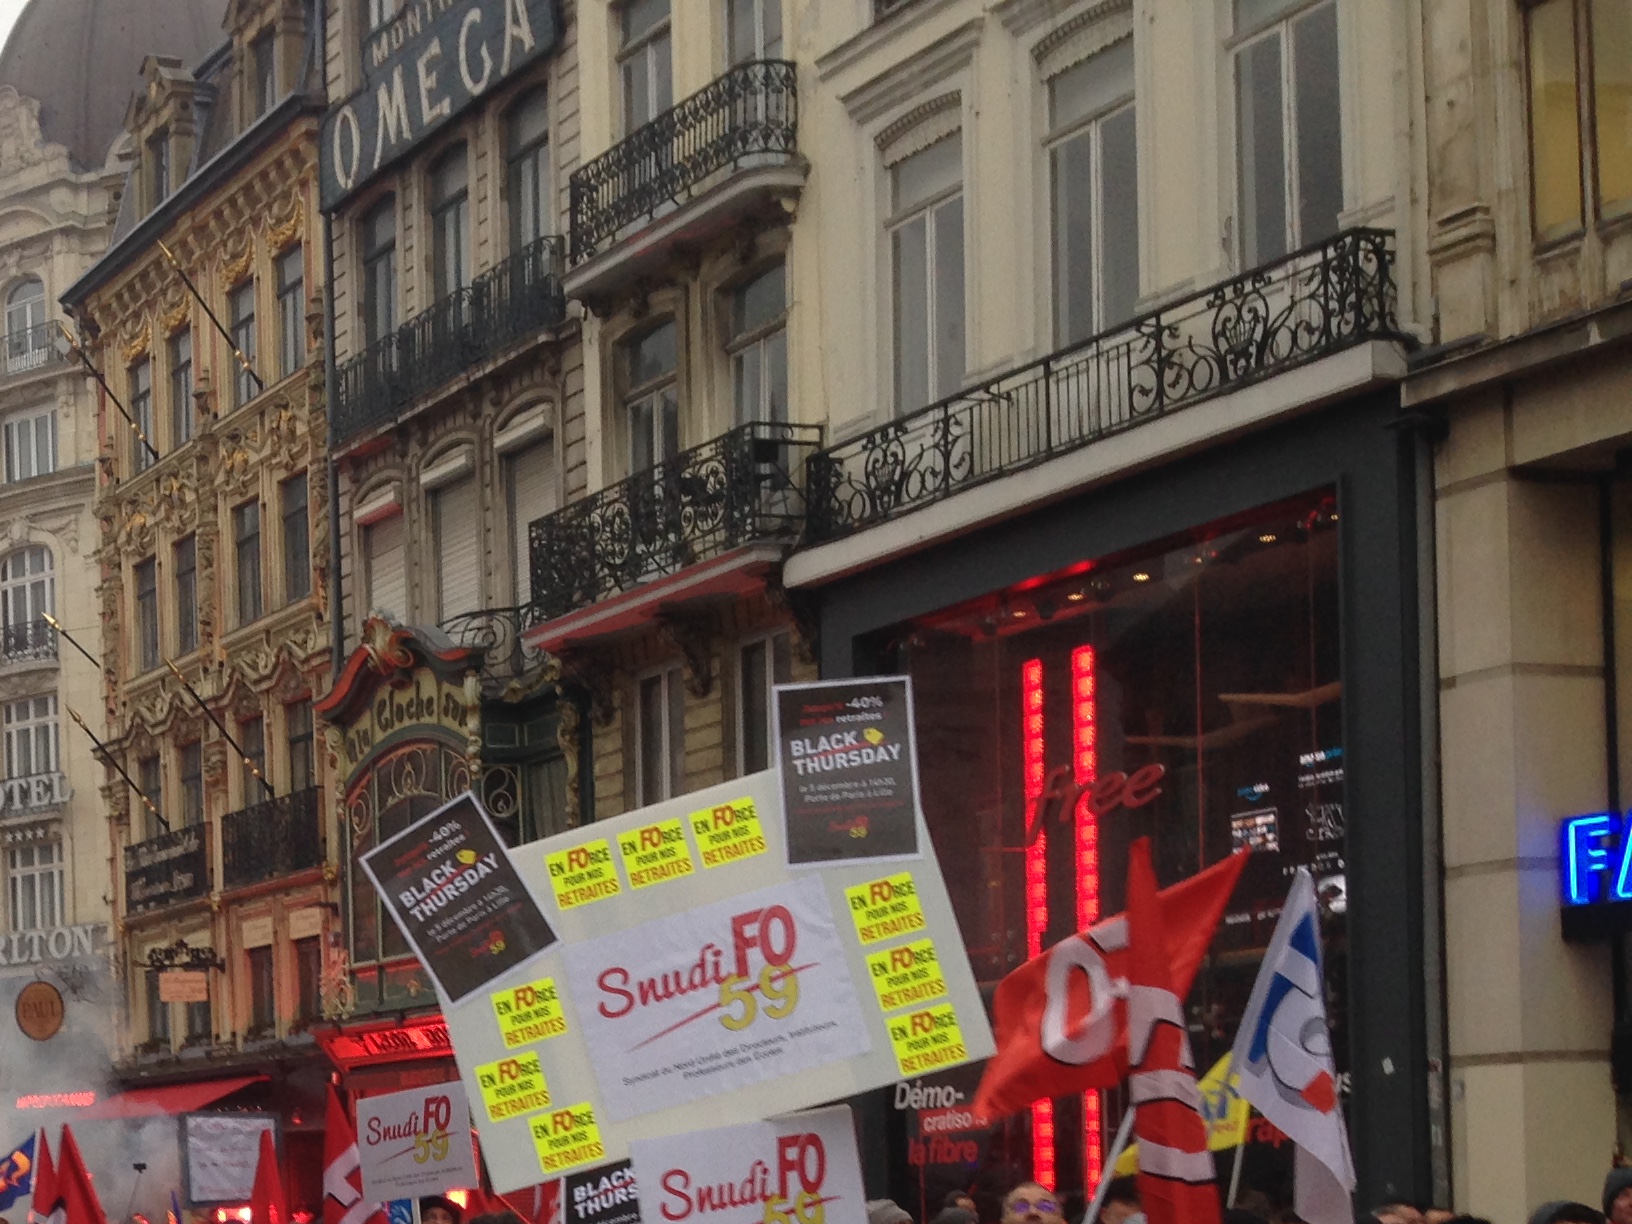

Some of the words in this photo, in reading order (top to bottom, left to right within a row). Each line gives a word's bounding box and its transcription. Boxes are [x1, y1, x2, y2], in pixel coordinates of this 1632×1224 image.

[333, 0, 535, 189] OMEGA
[846, 696, 884, 708] -40%
[790, 731, 859, 757] BLACK
[793, 743, 902, 775] THURSDAY
[694, 819, 710, 834] EN
[712, 805, 757, 829] FORCE
[1021, 763, 1165, 849] free
[428, 820, 462, 843] -40%
[622, 841, 637, 855] EN
[640, 826, 684, 851] FORCE
[708, 831, 731, 845] POUR
[733, 825, 749, 839] NOS
[549, 861, 565, 876] EN
[568, 848, 611, 872] FORCE
[635, 852, 658, 865] POUR
[659, 847, 676, 860] NOS
[703, 836, 766, 865] RETRAITES
[399, 860, 458, 908] BLACK
[409, 852, 499, 922] THURSDAY
[563, 872, 587, 887] POUR
[587, 868, 604, 882] NOS
[630, 858, 692, 887] RETRAITES
[558, 878, 618, 908] RETRAITES
[850, 895, 867, 910] EN
[870, 880, 916, 905] FORCE
[866, 906, 889, 919] POUR
[890, 901, 908, 914] NOS
[859, 912, 924, 942] RETRAITES
[597, 943, 731, 1019] Snudi
[731, 904, 796, 978] FO
[871, 962, 888, 977] EN
[890, 947, 937, 972] FORCE
[886, 973, 910, 987] POUR
[911, 967, 929, 980] NOS
[495, 1000, 512, 1015] EN
[513, 986, 558, 1010] FORCE
[719, 963, 800, 1031] 59
[880, 979, 946, 1009] RETRAITES
[22, 1000, 58, 1019] PAUL
[510, 1011, 533, 1025] POUR
[533, 1006, 551, 1017] NOS
[504, 1016, 565, 1046] RETRAITES
[891, 1025, 908, 1041] EN
[910, 1011, 957, 1037] FORCE
[907, 1037, 930, 1050] POUR
[931, 1032, 949, 1044] NOS
[900, 1043, 966, 1073] RETRAITES
[480, 1073, 497, 1088] EN
[498, 1059, 541, 1084] FORCE
[494, 1084, 516, 1098] POUR
[517, 1079, 534, 1091] NOS
[894, 1080, 964, 1109] Démo-
[488, 1090, 550, 1120] RETRAITES
[367, 1111, 423, 1146] Snudi
[423, 1095, 451, 1135] FO
[533, 1124, 549, 1139] EN
[551, 1110, 595, 1135] FORCE
[413, 1128, 449, 1164] 59
[547, 1135, 570, 1149] POUR
[570, 1131, 588, 1142] NOS
[929, 1134, 979, 1164] fibre
[542, 1141, 604, 1170] RETRAITES
[573, 1167, 636, 1202] BLACK
[660, 1159, 774, 1221] Snudi
[777, 1132, 826, 1199] FO
